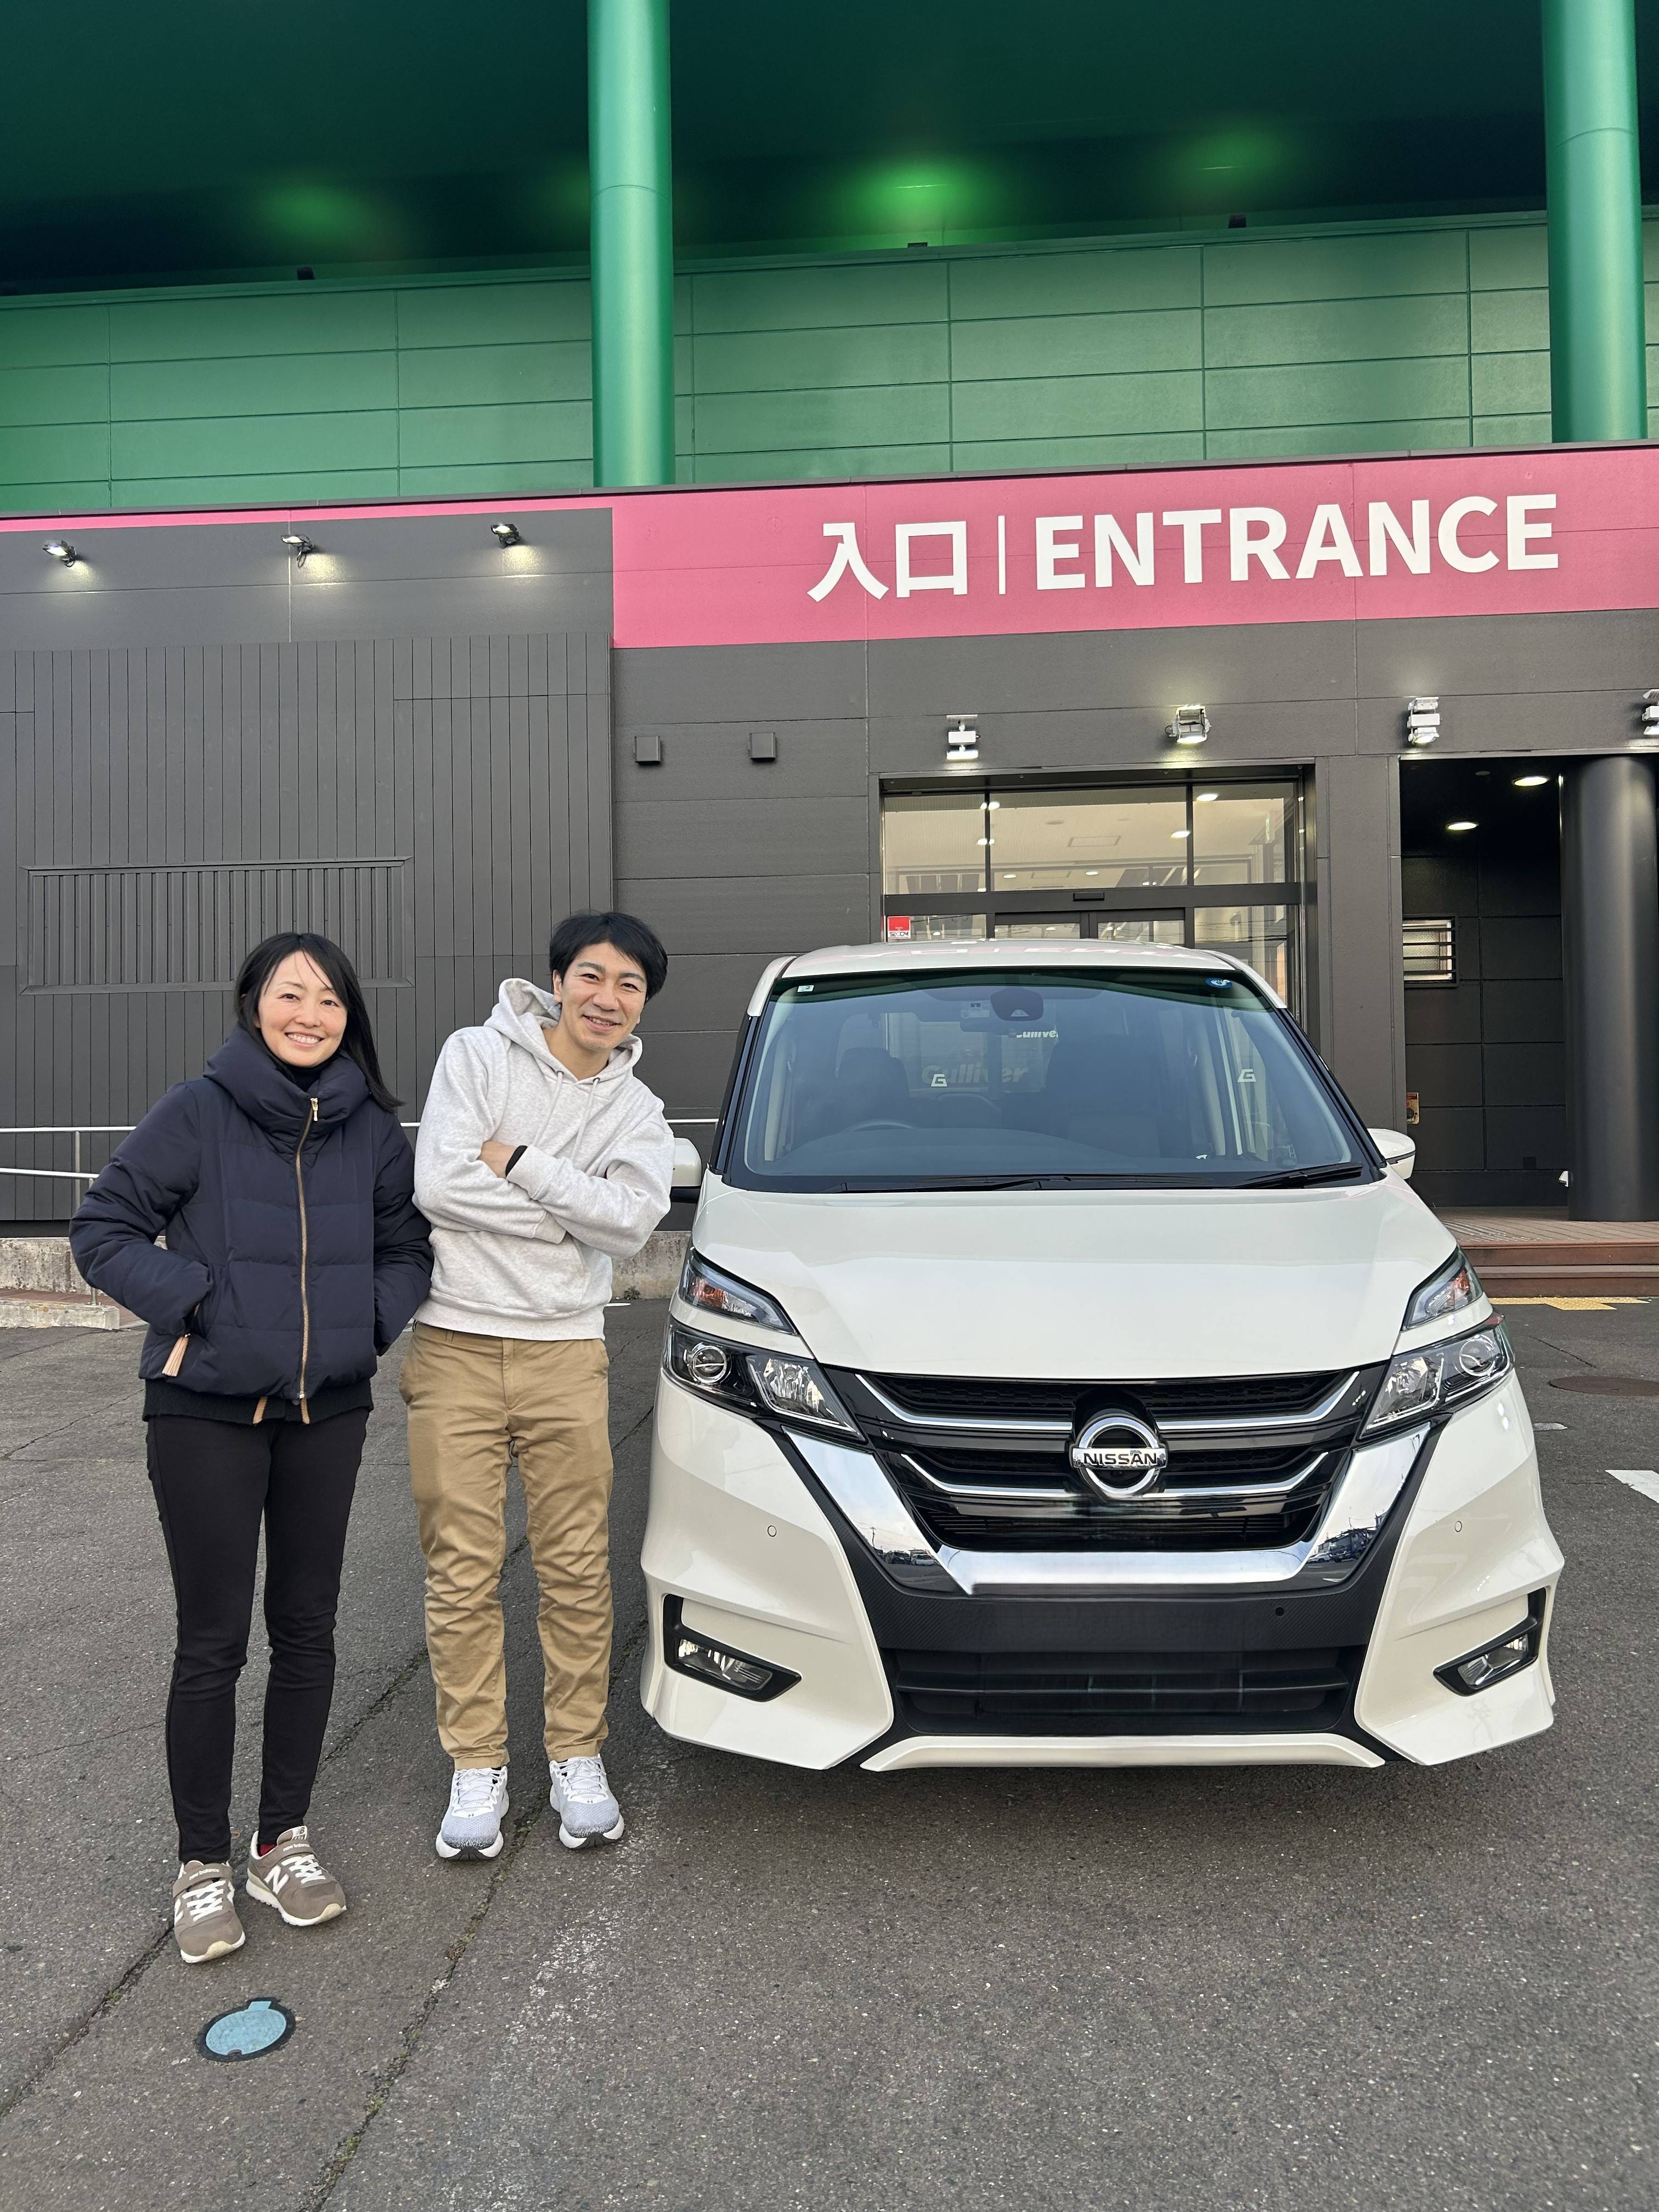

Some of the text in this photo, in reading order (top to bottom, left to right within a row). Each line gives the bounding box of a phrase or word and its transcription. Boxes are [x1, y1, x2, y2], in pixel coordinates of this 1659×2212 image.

[807, 494, 1558, 602] 入口 ENTRANCE
[922, 1062, 1029, 1084] Gullier
[1084, 1453, 1156, 1464] NISSAN
